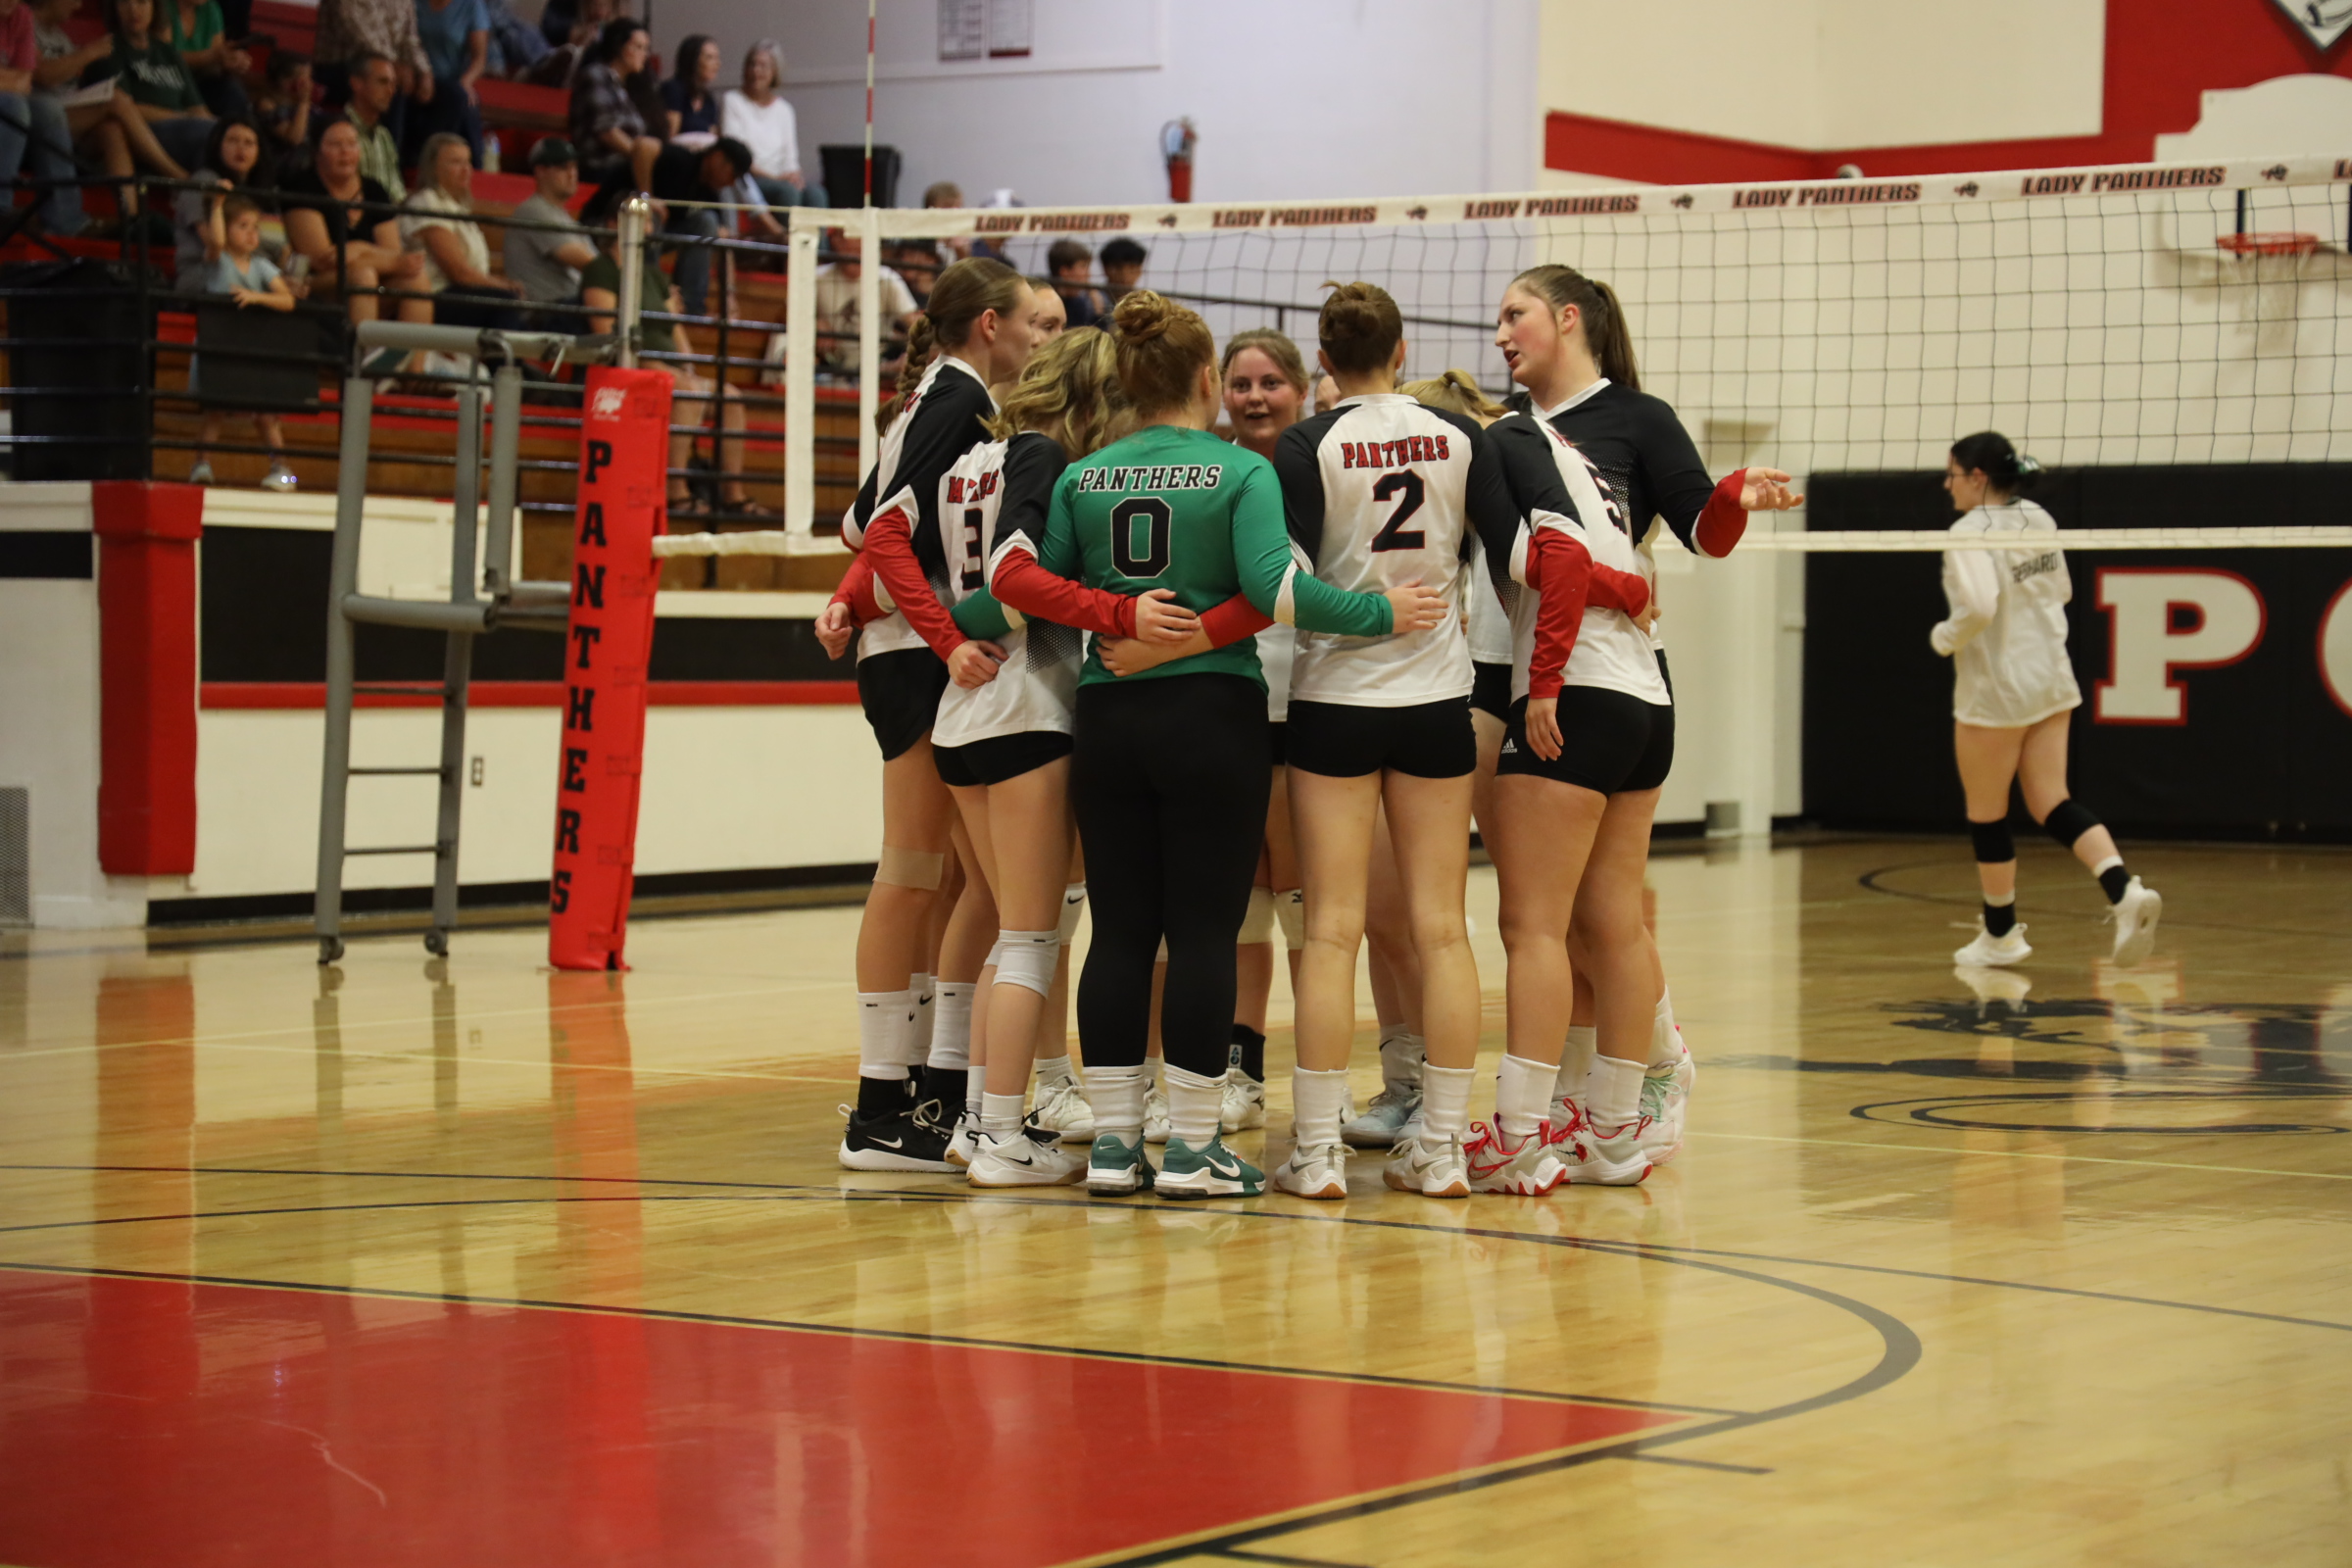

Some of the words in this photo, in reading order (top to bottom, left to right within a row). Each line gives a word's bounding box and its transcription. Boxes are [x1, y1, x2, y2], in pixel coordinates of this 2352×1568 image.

[1732, 188, 1794, 209] LADY
[1797, 183, 1922, 206] PANTHERS
[2021, 174, 2088, 196] LADY
[2090, 166, 2227, 192] PANTHERS
[974, 215, 1025, 232] LADY
[1029, 213, 1131, 231] PANTHERS
[1212, 210, 1266, 228] LADY
[1269, 205, 1378, 227] PANTHERS
[1463, 200, 1520, 220] LADY
[1524, 195, 1641, 218] PANTHERS
[1341, 435, 1449, 468] PANTHERS
[1078, 465, 1222, 492] PANTHERS
[1371, 468, 1425, 553] 2
[960, 508, 985, 591] 3
[1110, 496, 1172, 579] 0
[2094, 565, 2352, 727] P
[551, 439, 612, 914] PANTHERS
